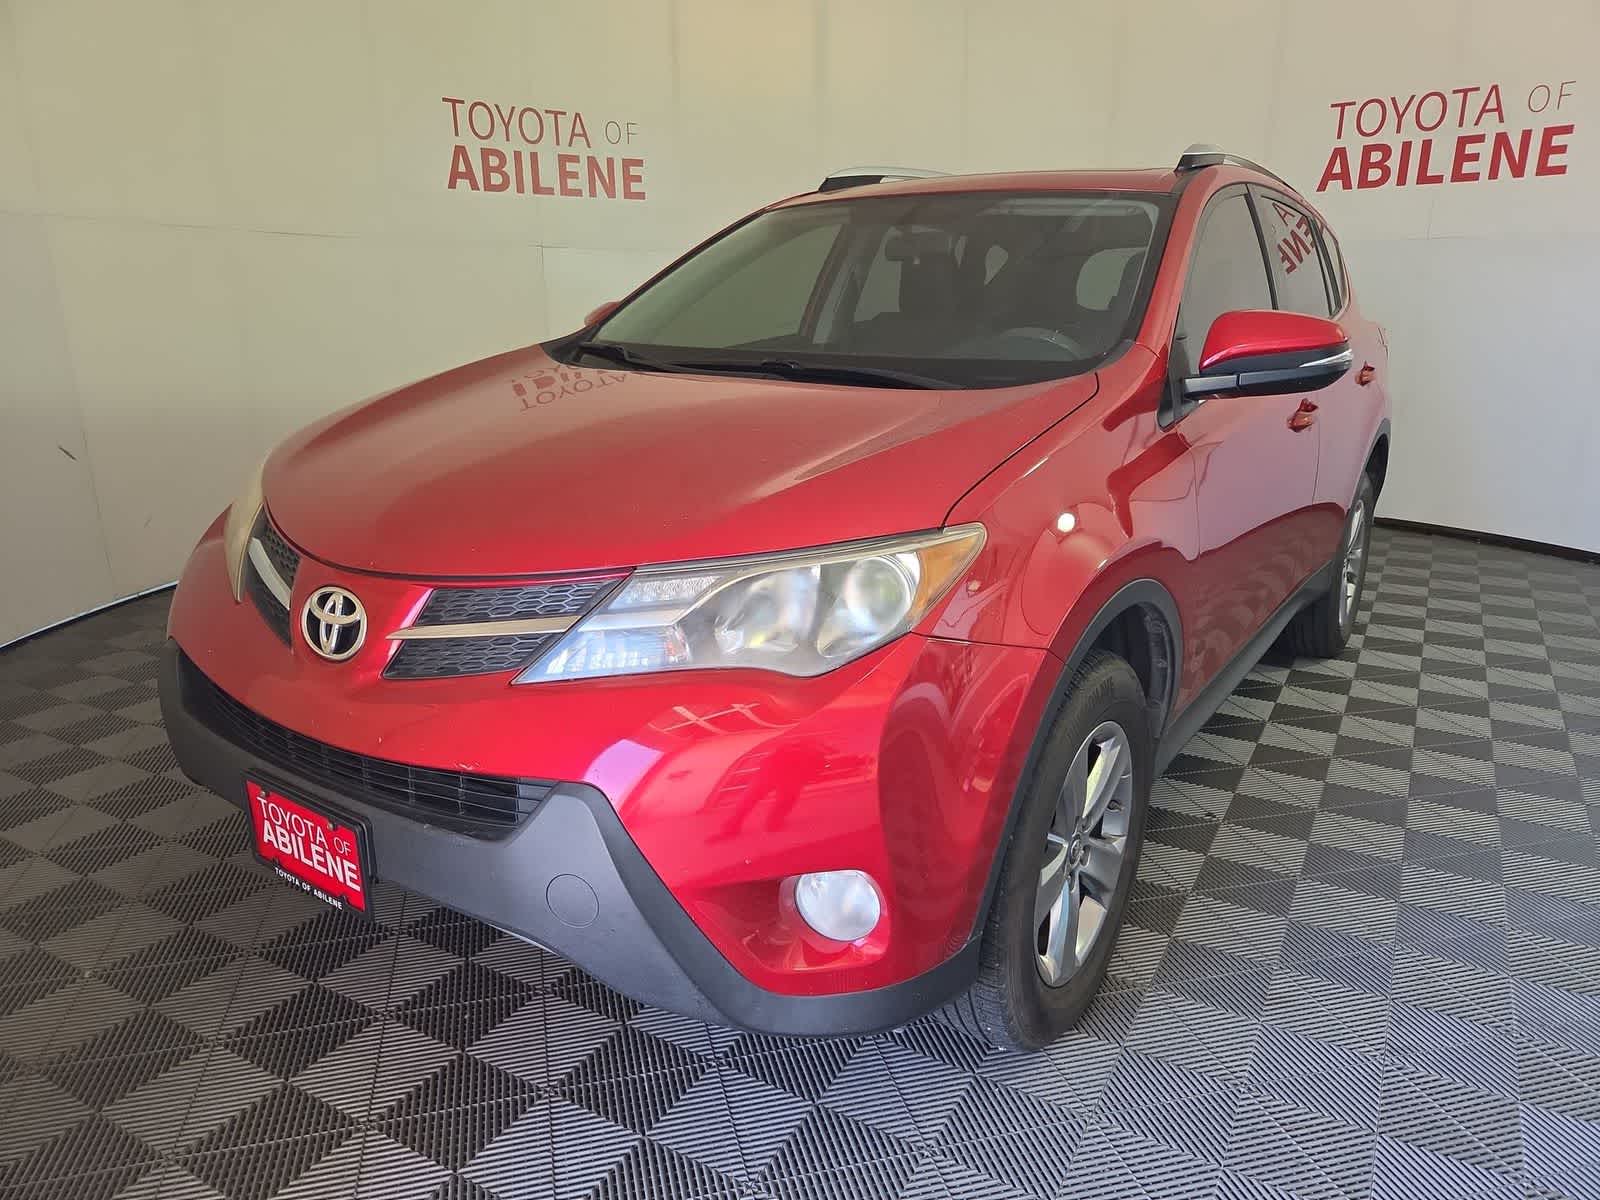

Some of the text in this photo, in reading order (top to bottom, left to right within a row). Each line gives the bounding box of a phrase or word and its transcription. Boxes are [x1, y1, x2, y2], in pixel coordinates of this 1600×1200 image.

[442, 97, 638, 148] TOYOTA OF
[1330, 80, 1576, 139] TOYOTA OF
[447, 144, 646, 200] ABILENE
[1316, 124, 1575, 192] ABILENE
[257, 796, 352, 856] TOYOTA OF
[263, 820, 361, 892] ABILENE
[274, 867, 343, 910] TOYOTA OF ABILENE
